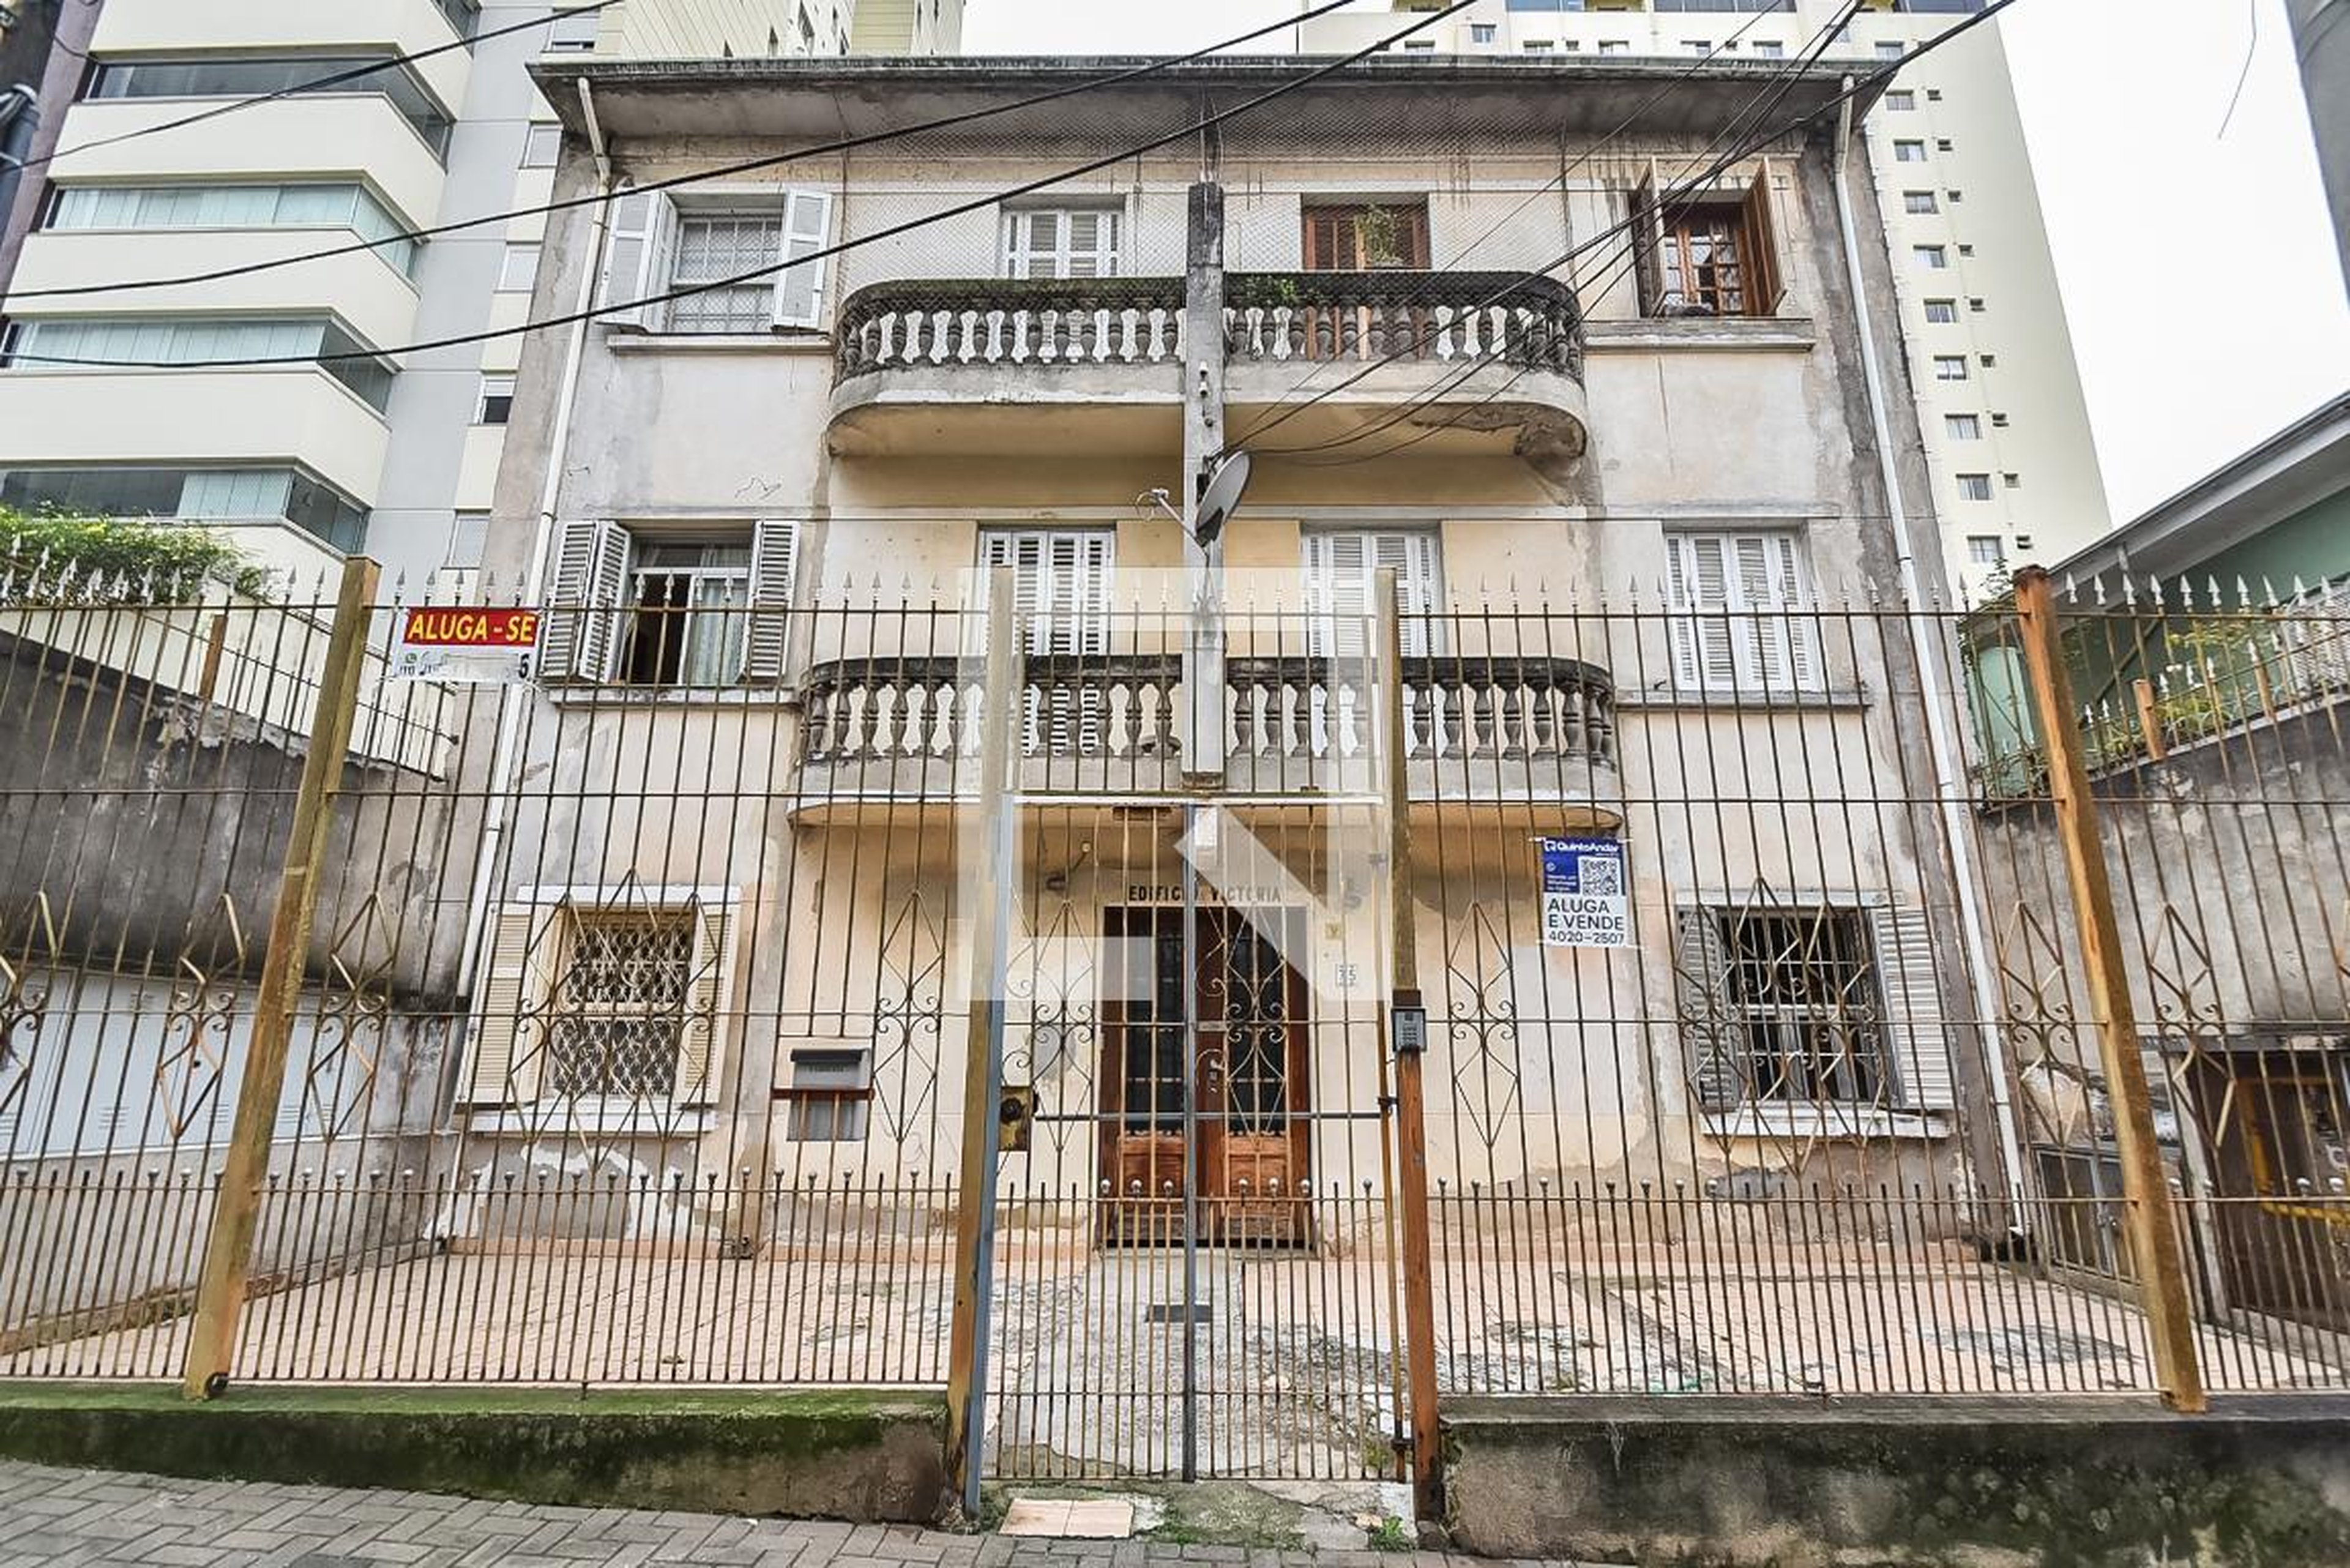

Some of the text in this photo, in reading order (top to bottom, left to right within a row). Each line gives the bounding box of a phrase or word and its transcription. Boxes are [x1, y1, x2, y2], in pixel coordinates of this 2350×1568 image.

[1557, 842, 1619, 852] QuintoAndar
[1548, 898, 1610, 913] ALUGA
[1549, 914, 1624, 930] E VENDE
